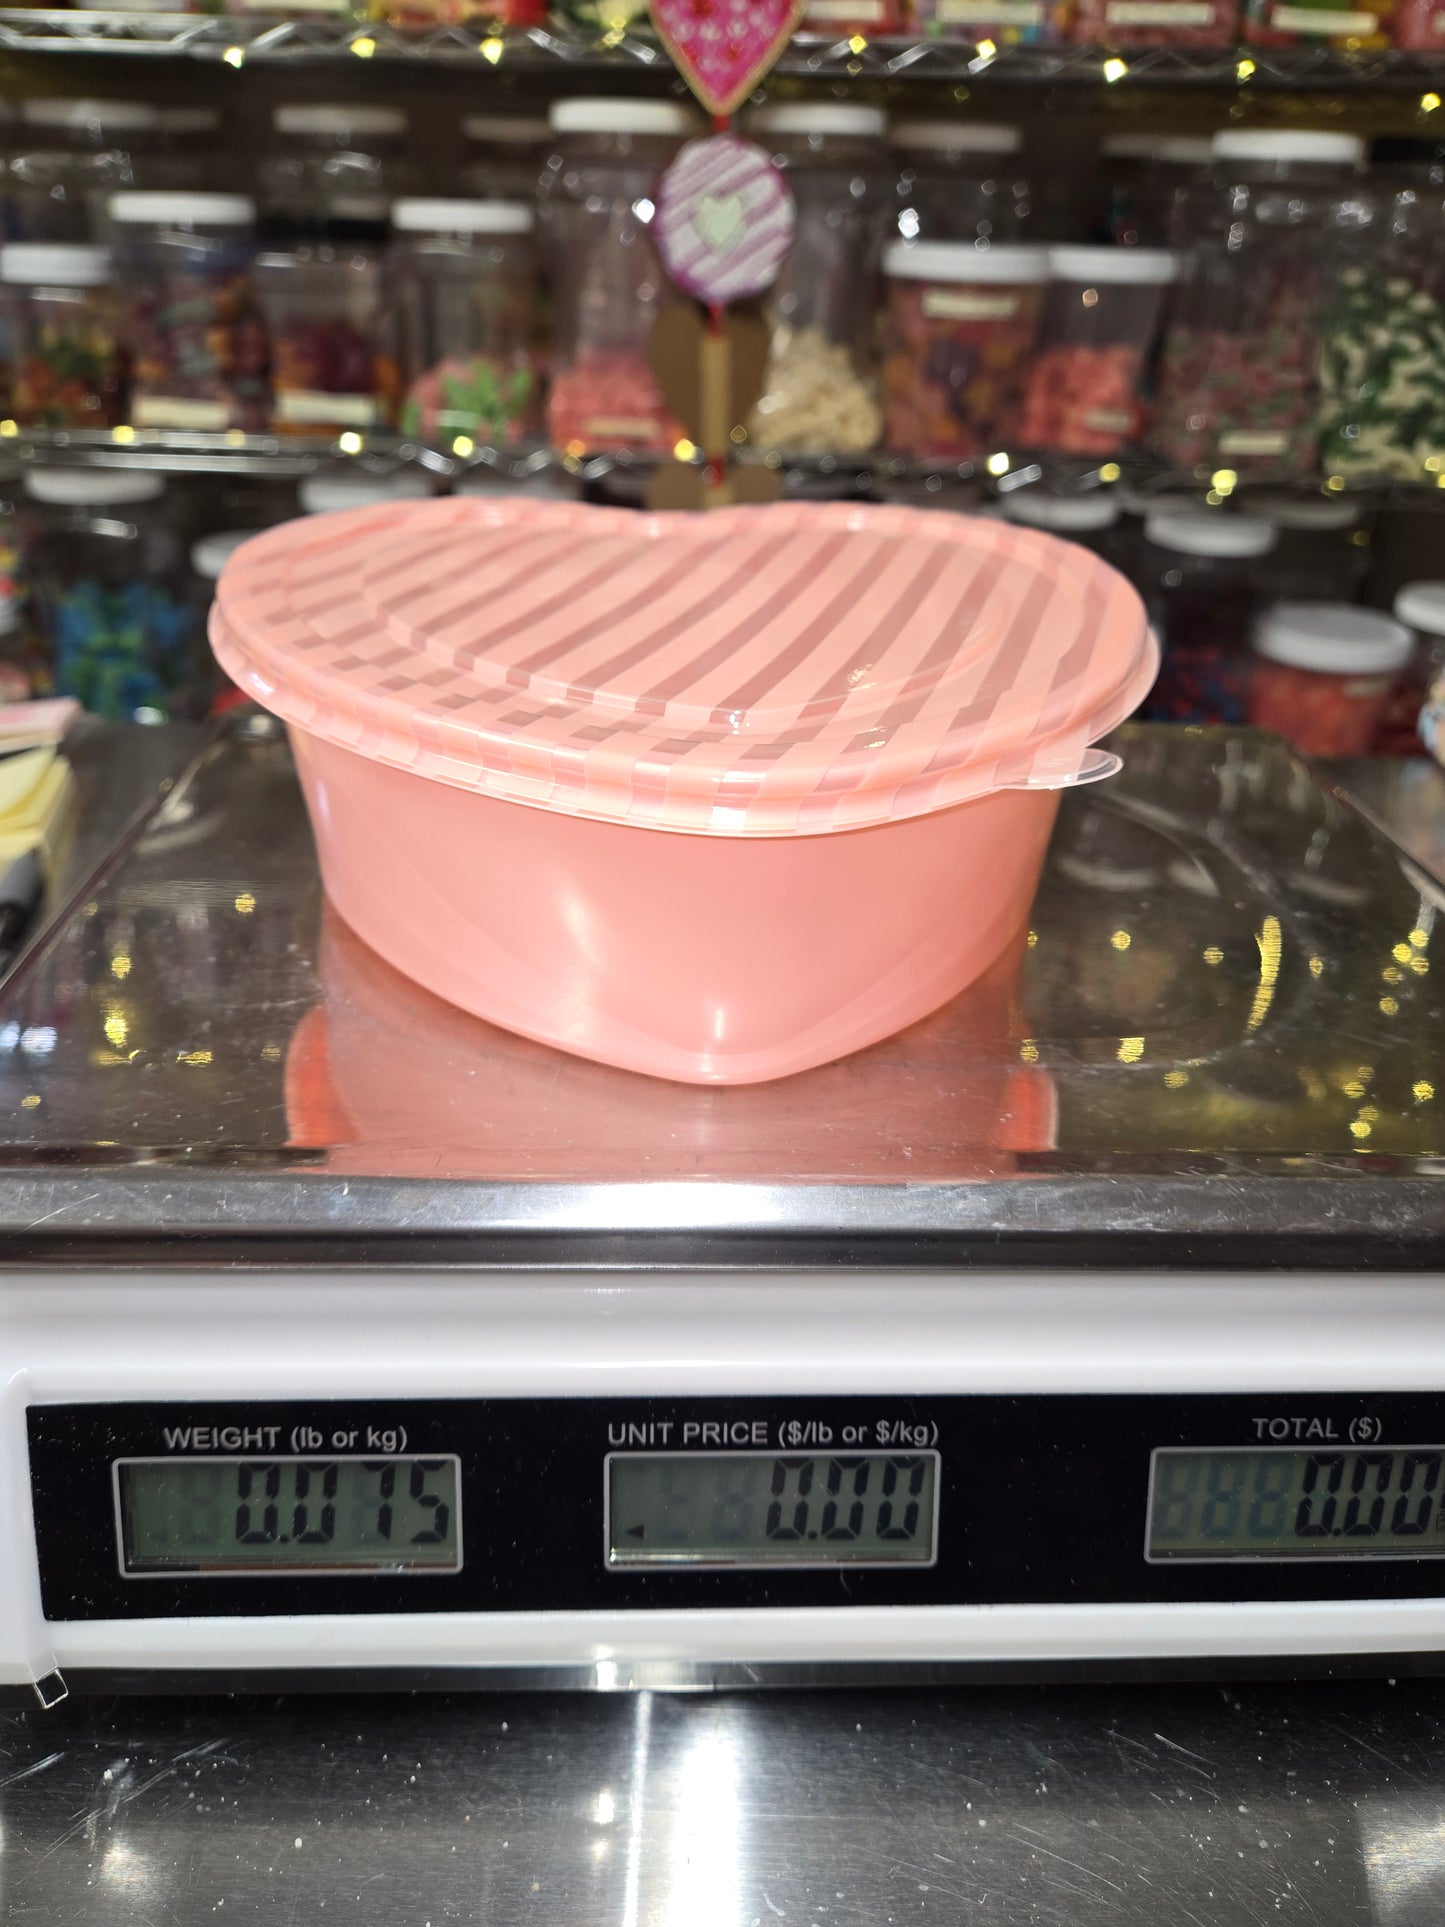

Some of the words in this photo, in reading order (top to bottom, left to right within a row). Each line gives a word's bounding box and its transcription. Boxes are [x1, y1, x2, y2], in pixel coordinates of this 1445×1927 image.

[163, 1426, 281, 1449] WEIGHT
[291, 1426, 323, 1452] (lb
[332, 1430, 358, 1448] or
[367, 1425, 408, 1451] kg)
[608, 1422, 673, 1444] UNIT
[684, 1422, 768, 1443] PRICE
[778, 1420, 833, 1447] ($/lb
[842, 1425, 868, 1442] or
[876, 1420, 938, 1446] $/kg)
[1252, 1418, 1339, 1439] TOTAL
[1349, 1416, 1382, 1442] ($)
[236, 1459, 449, 1543] 0.075
[766, 1456, 925, 1540] 0.00
[1295, 1454, 1441, 1537] 0.00
